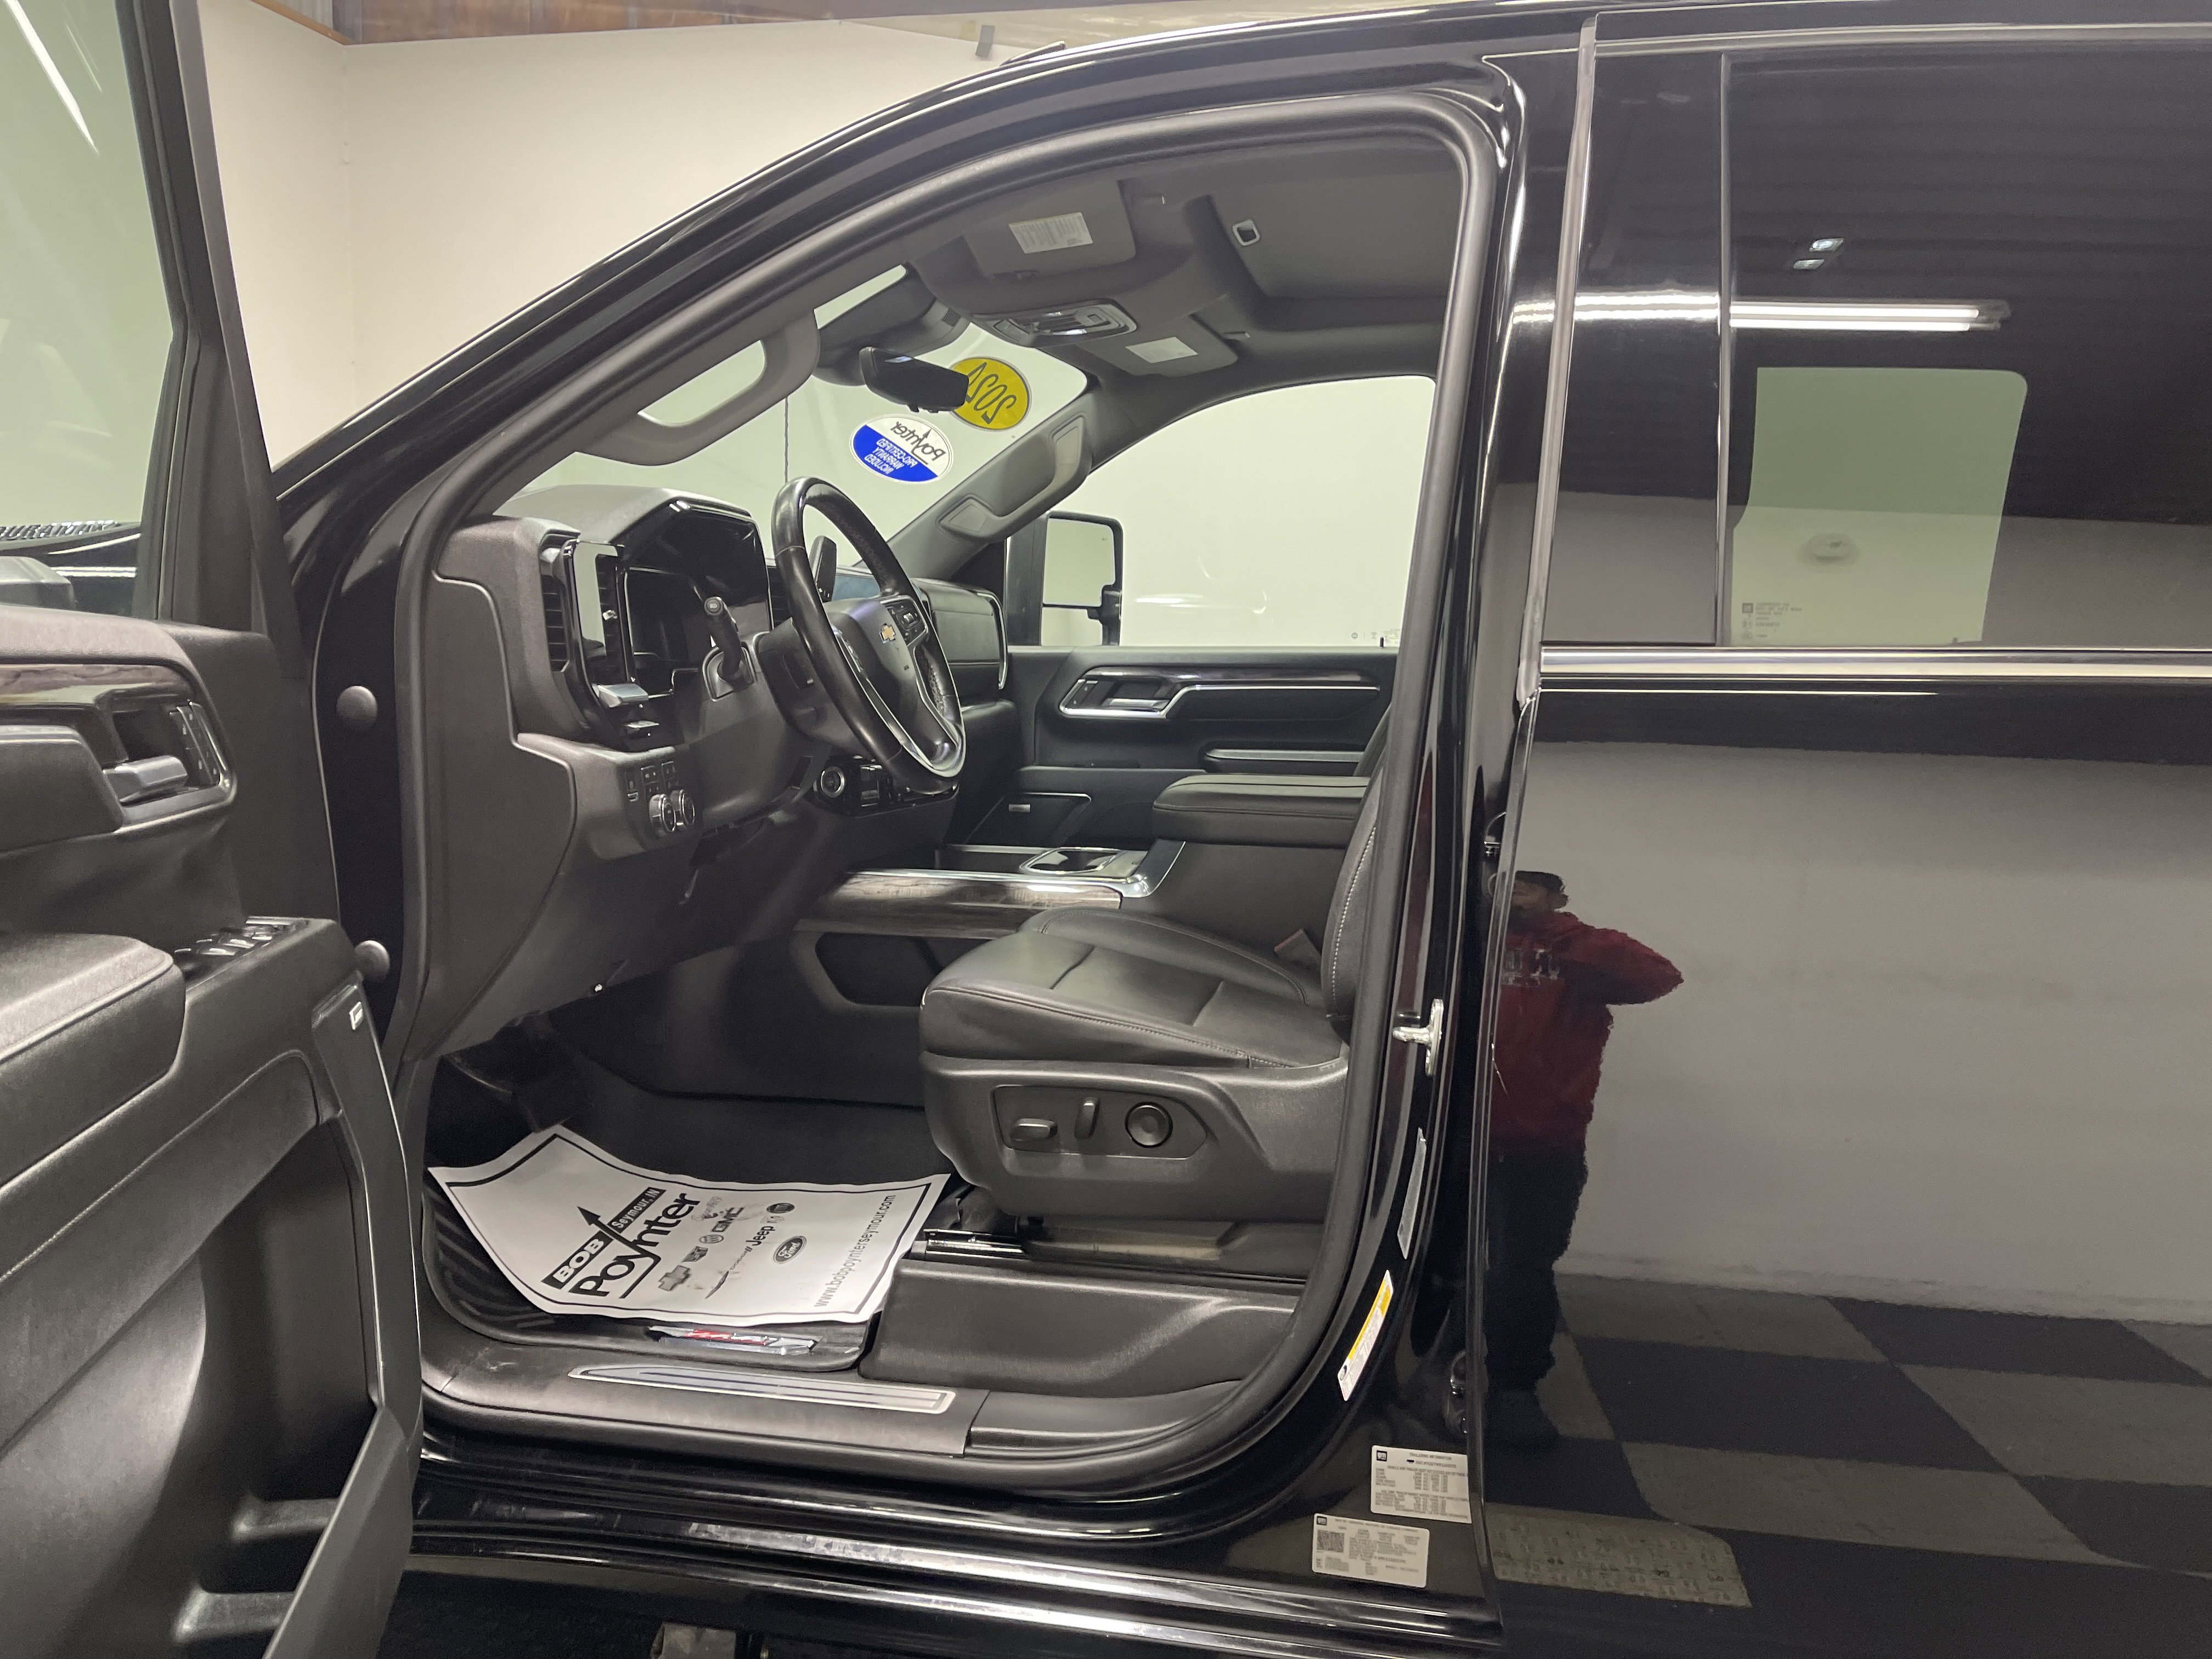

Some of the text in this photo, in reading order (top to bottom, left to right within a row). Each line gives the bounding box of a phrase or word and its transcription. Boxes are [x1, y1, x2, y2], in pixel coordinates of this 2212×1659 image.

[612, 1189, 660, 1229] Seymour, IN
[712, 1207, 745, 1232] GMC
[568, 1193, 701, 1299] Poynter
[746, 1225, 776, 1246] Jeep
[814, 1195, 896, 1307] www.bobpoynterseymour.com
[552, 1238, 605, 1283] BOB
